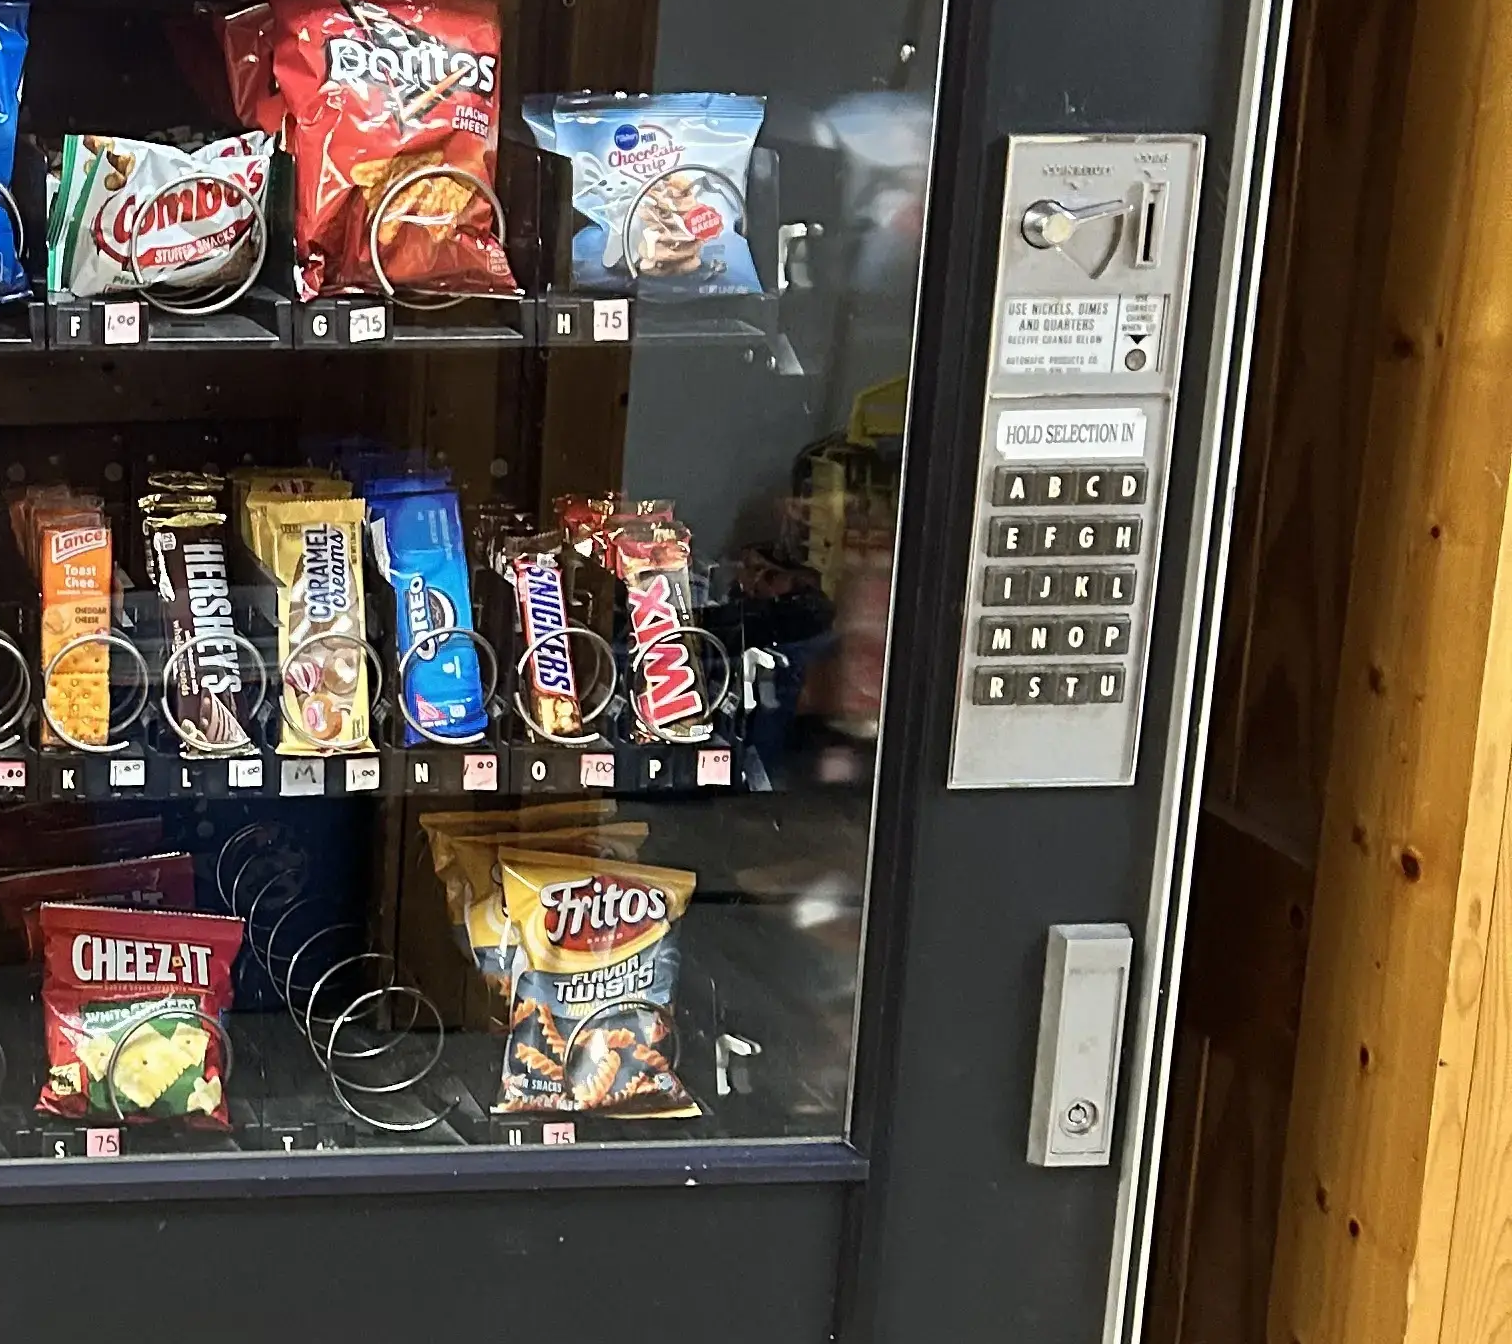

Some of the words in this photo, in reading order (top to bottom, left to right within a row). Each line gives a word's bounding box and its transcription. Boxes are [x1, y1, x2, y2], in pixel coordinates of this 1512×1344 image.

[330, 38, 496, 92] Doritos
[632, 157, 666, 174] Chip
[195, 226, 237, 254] SNACKS
[1008, 303, 1028, 315] USE
[1078, 302, 1108, 315] DIMES
[70, 315, 80, 338] F
[312, 315, 328, 337] G
[557, 313, 571, 335] H
[1019, 319, 1039, 331] AND
[1043, 318, 1095, 331] QUARTERS
[1006, 424, 1044, 445] HOLD
[1045, 422, 1118, 444] SELECTION
[1121, 422, 1135, 443] IN
[1010, 476, 1025, 499] A
[1047, 476, 1062, 498] B
[1087, 475, 1100, 497] C
[1121, 476, 1137, 497] D
[55, 529, 102, 553] Lance
[1006, 527, 1018, 550] E
[1044, 526, 1056, 549] F
[1078, 526, 1094, 548] G
[1116, 525, 1131, 548] H
[64, 564, 96, 576] Toast
[306, 523, 329, 618] CARAMEL
[331, 530, 345, 609] creams
[1003, 577, 1012, 599] I
[1039, 576, 1051, 598] J
[1074, 575, 1088, 597] K
[1112, 576, 1123, 599] L
[183, 543, 241, 694] HERSHEY'S
[410, 576, 437, 660] OREO
[528, 565, 571, 694] SNICKERS
[991, 628, 1011, 650] M
[1031, 627, 1047, 649] N
[1068, 626, 1084, 648] O
[1105, 626, 1120, 648] P
[629, 576, 703, 726] TWIX
[989, 676, 1003, 698] R
[1028, 676, 1041, 698] S
[1066, 676, 1079, 698] T
[1100, 674, 1115, 697] U
[62, 769, 75, 789] K
[181, 768, 191, 788] L
[295, 764, 316, 784] M
[414, 762, 429, 783] N
[531, 760, 546, 781] O
[649, 759, 662, 778] P
[541, 876, 667, 943] Fritos
[571, 954, 639, 984] FLAVOR
[553, 964, 655, 1002] TWISTS
[532, 1079, 563, 1093] SNACKS
[54, 1140, 65, 1158] S
[95, 1135, 119, 1153] 75
[282, 1135, 294, 1151] T
